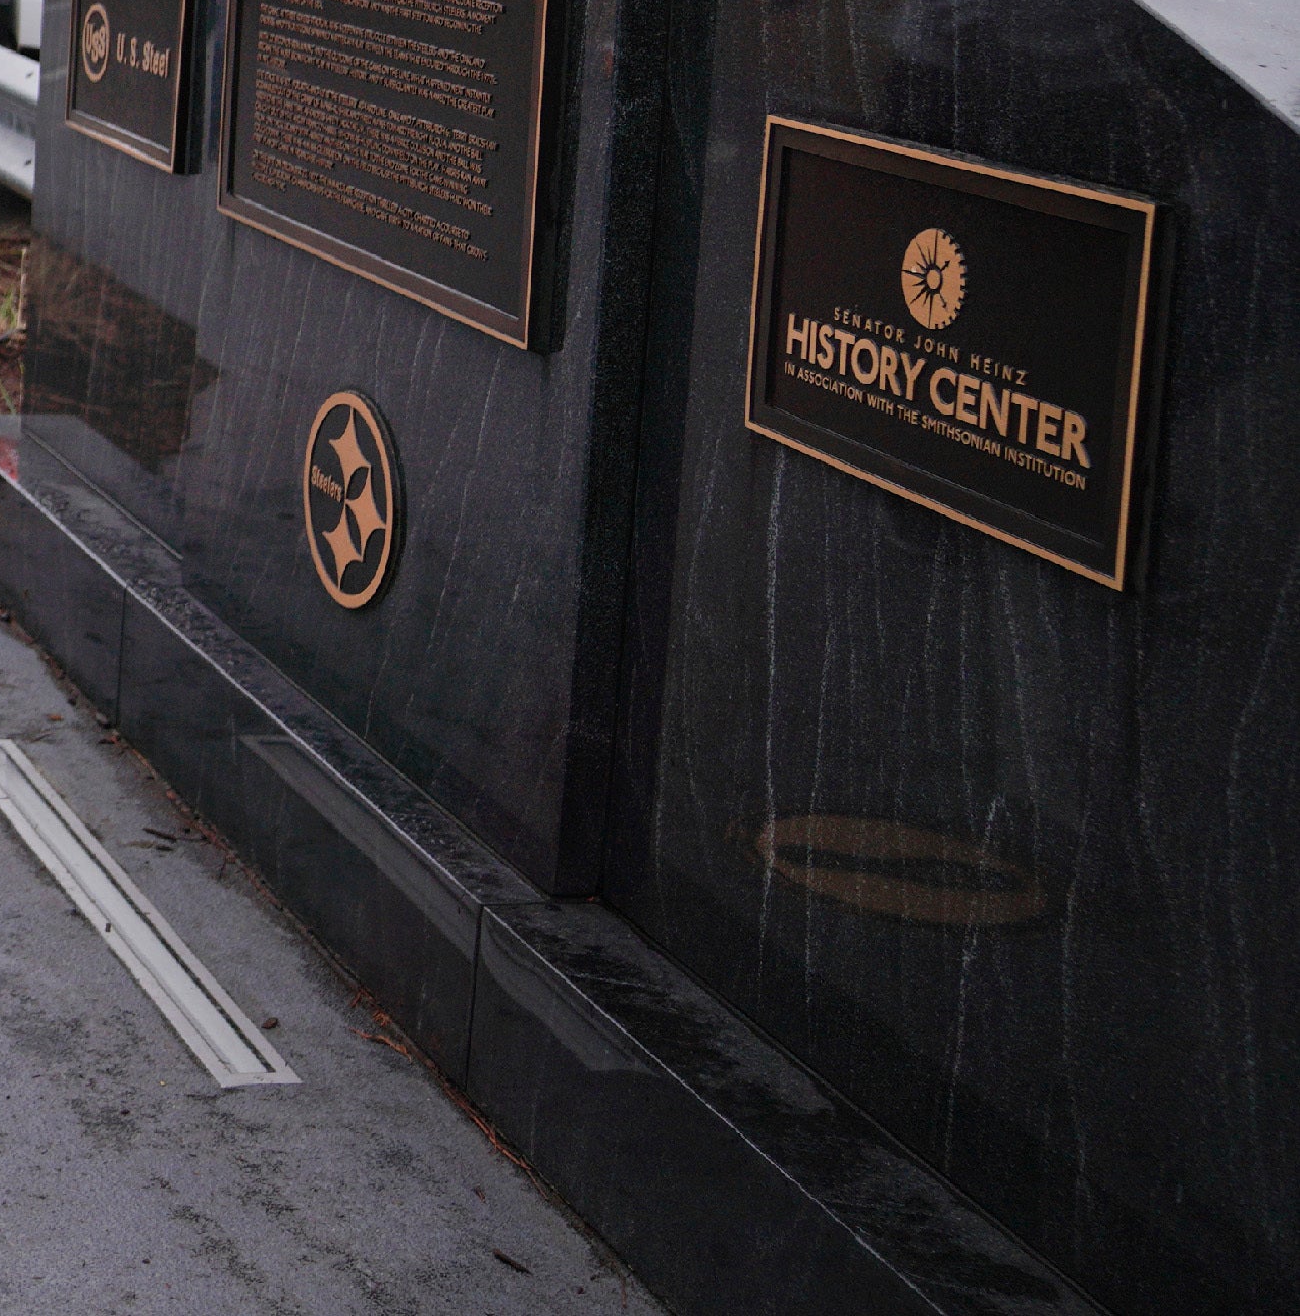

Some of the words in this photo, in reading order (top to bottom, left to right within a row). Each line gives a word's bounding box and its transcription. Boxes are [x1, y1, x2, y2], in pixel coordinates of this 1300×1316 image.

[142, 39, 172, 80] Steel
[833, 306, 905, 344] SENATOR
[913, 334, 960, 365] JOHN
[969, 354, 1029, 386] HEINZ
[783, 361, 796, 377] IN
[796, 363, 864, 402] ASSOCIATION
[866, 389, 895, 416] WITH
[897, 403, 919, 425] THE
[921, 414, 1001, 457] SMITHSONIAN
[1003, 446, 1087, 492] INSTITUTION
[786, 312, 926, 403] HISTORY
[929, 366, 1091, 469] CENTER
[310, 464, 342, 503] Steelers
